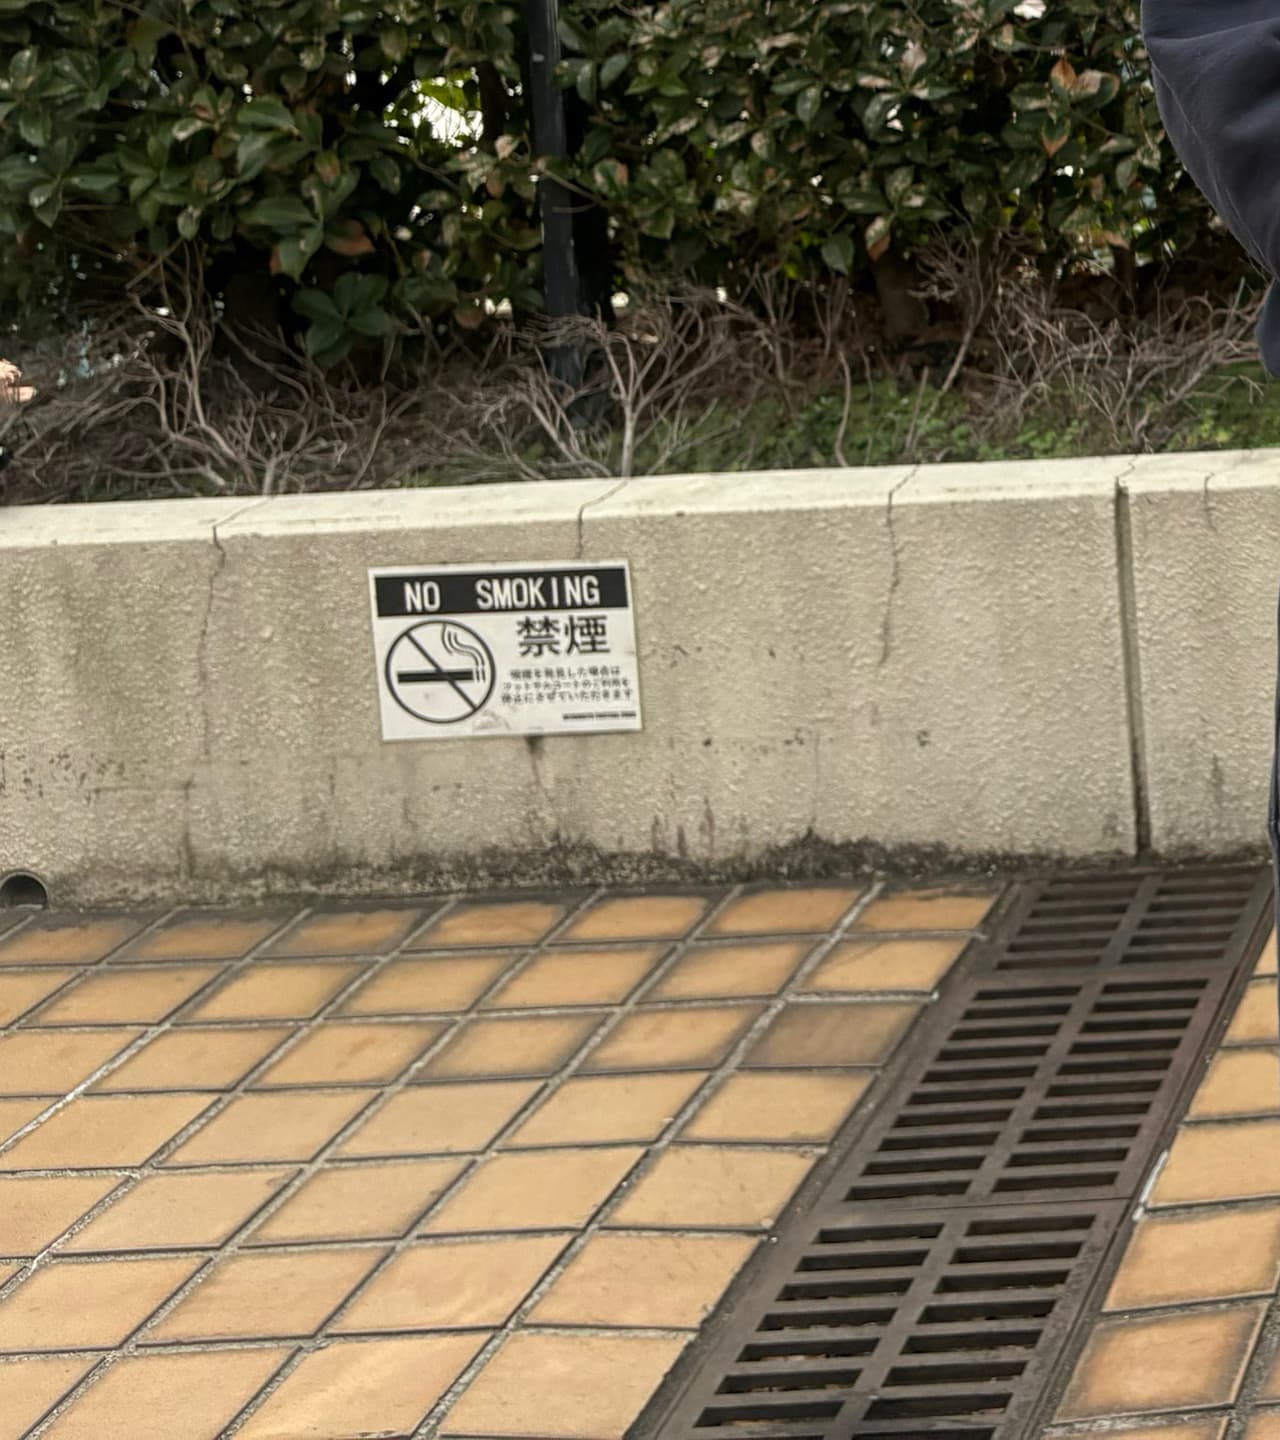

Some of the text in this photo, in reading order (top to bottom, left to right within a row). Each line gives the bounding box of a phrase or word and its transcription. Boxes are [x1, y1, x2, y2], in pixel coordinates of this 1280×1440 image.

[404, 575, 600, 612] NO SMOKING
[517, 615, 610, 657] 禁煙
